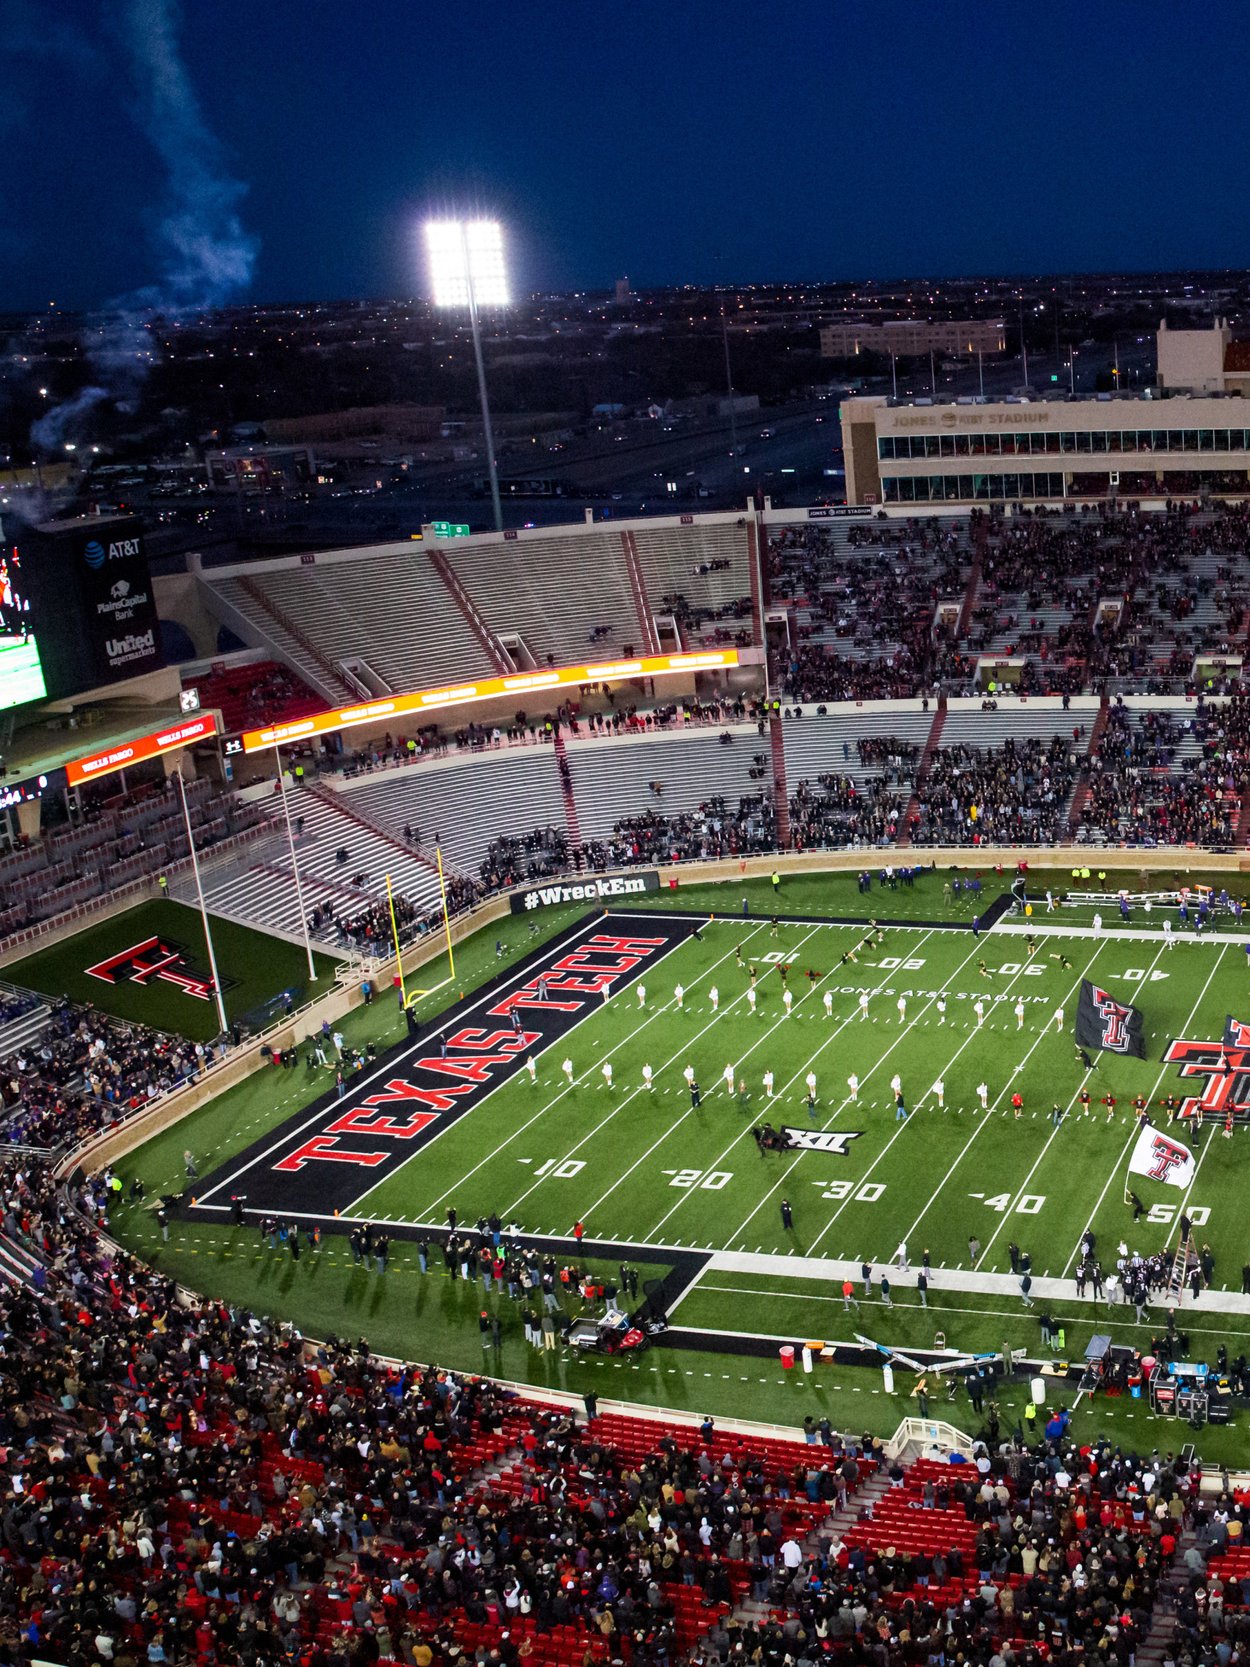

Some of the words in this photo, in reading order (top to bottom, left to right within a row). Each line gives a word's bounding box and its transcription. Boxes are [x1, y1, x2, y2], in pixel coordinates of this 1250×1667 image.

[892, 415, 937, 427] JONES
[959, 414, 983, 424] AT&T
[988, 412, 1049, 424] STADIUM
[108, 538, 140, 560] AT&T
[96, 592, 147, 614] PlainsCapital
[114, 608, 135, 621] Bank
[105, 629, 154, 657] United
[109, 646, 156, 666] supermarkets
[181, 691, 198, 708] 25
[156, 731, 181, 746] WELLS
[181, 723, 204, 738] FARGO
[81, 757, 109, 773] WELLS
[109, 748, 134, 764] FARGO
[524, 877, 646, 911] #WreckEm
[760, 951, 801, 964] 10
[877, 956, 927, 970] 20
[486, 934, 670, 1017] TECH
[998, 962, 1047, 976] 30
[1121, 968, 1170, 982] 40
[828, 986, 896, 996] JONES
[900, 989, 951, 999] AT&T
[955, 991, 1050, 1004] STADIUM
[271, 1027, 544, 1172] TEXAS
[532, 1157, 588, 1178] 10
[668, 1168, 735, 1190] 20
[820, 1180, 888, 1203] 30
[983, 1192, 1047, 1214] 40
[1146, 1203, 1212, 1226] 50
